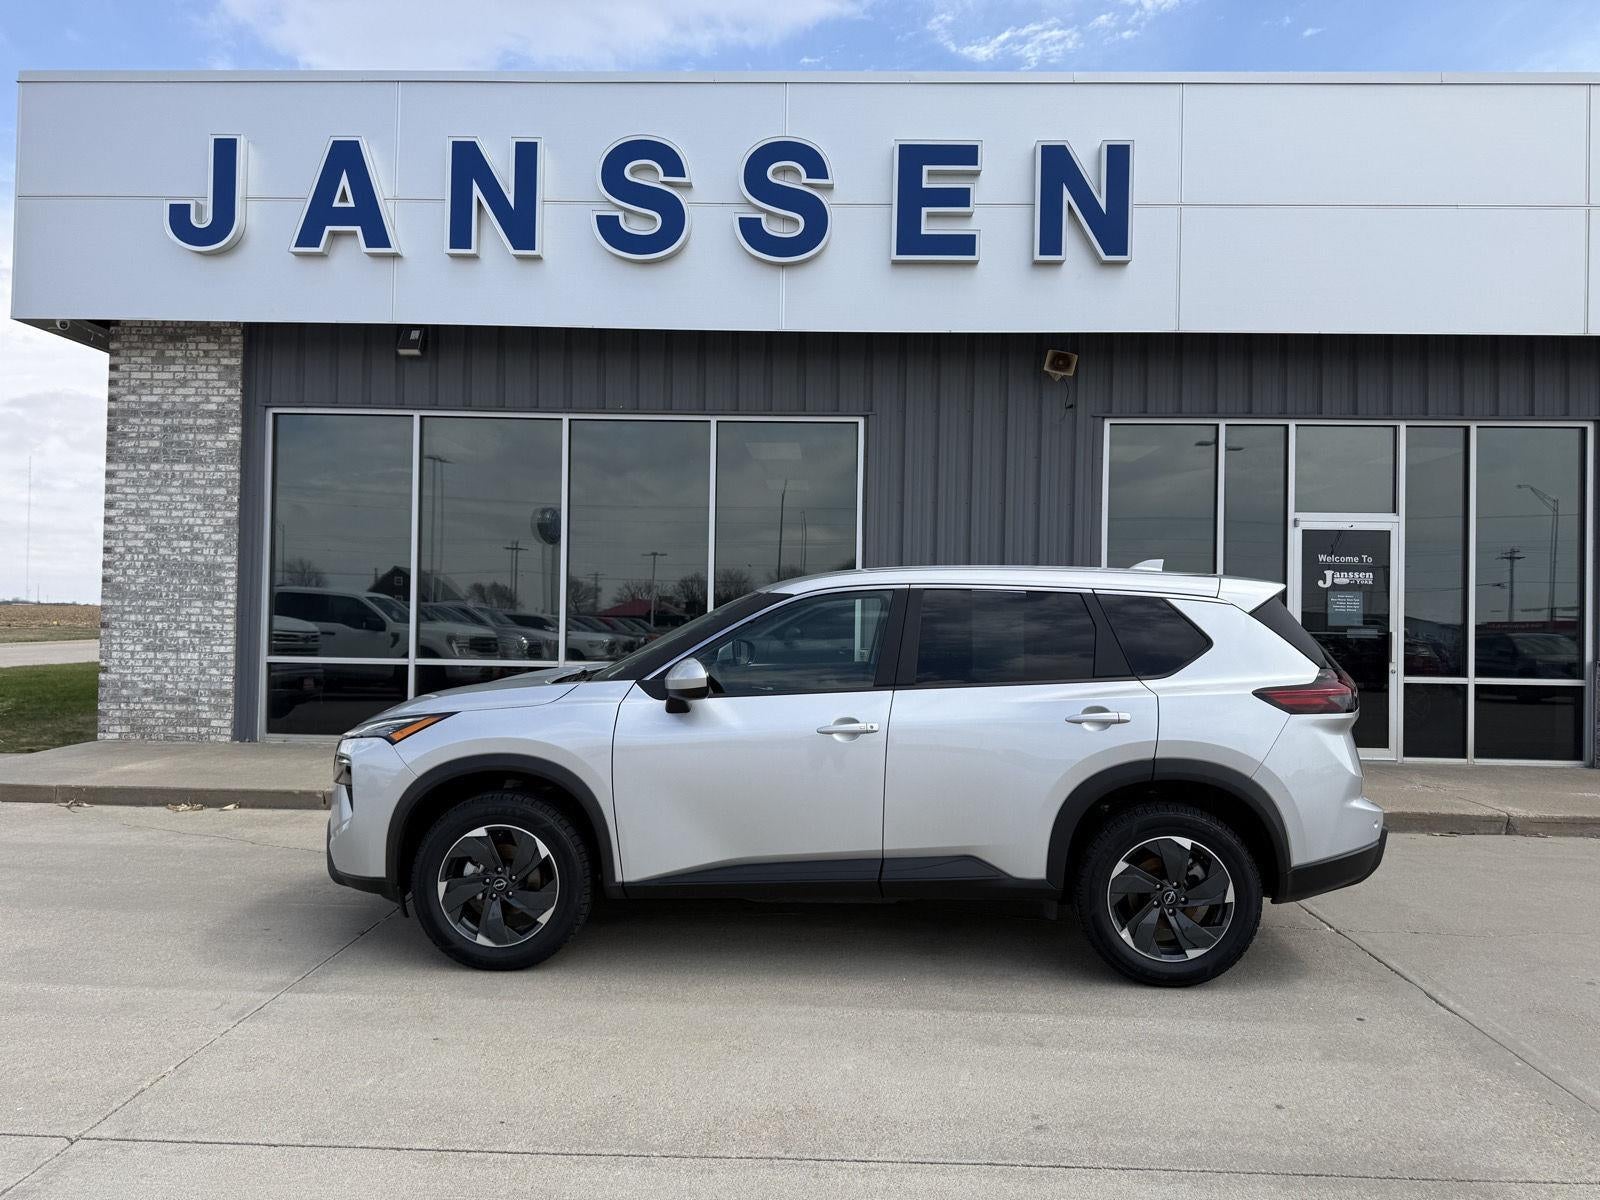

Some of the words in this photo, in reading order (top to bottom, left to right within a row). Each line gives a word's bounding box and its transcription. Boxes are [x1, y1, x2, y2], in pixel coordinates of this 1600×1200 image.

[164, 134, 1134, 263] JANSSEN
[1318, 554, 1359, 563] Welcome
[1361, 554, 1373, 563] To
[1317, 570, 1374, 588] Janssen
